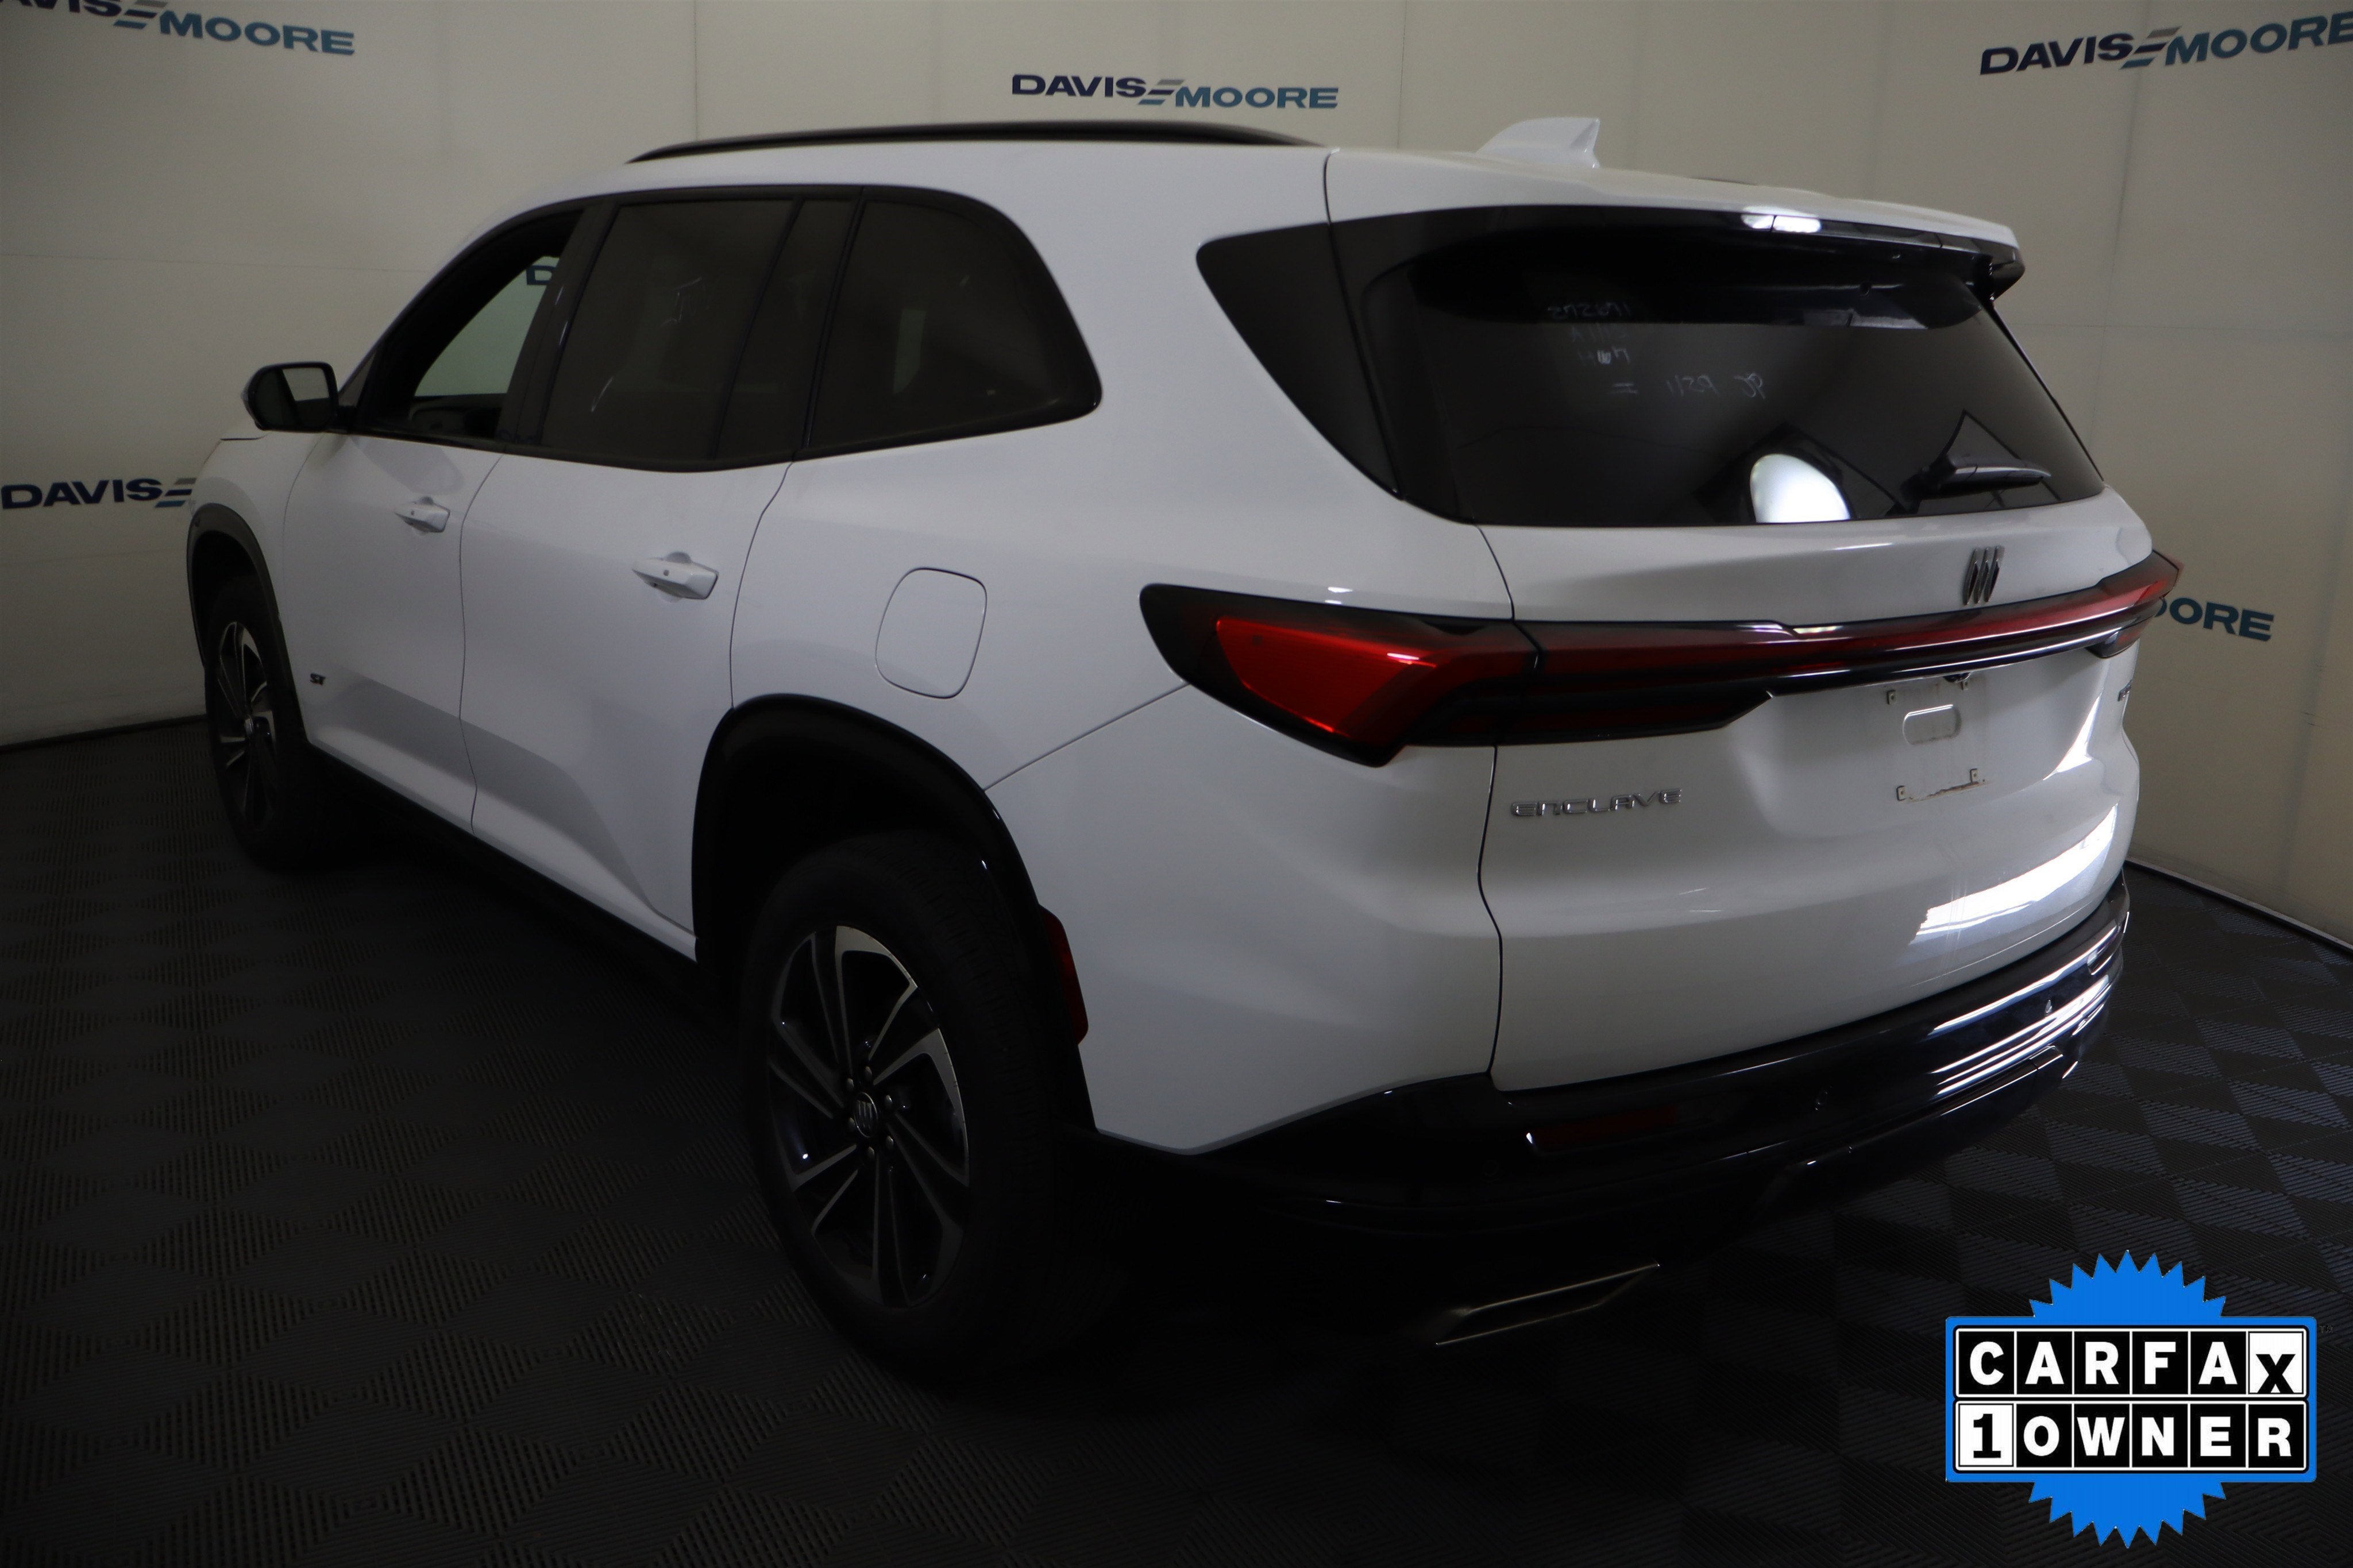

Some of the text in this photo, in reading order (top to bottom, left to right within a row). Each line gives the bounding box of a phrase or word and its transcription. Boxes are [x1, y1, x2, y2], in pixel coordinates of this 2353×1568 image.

[160, 9, 354, 56] MOORE
[1980, 11, 2353, 75] DAVIS MOORE
[1012, 74, 1338, 109] DAVIS MOORE
[1, 478, 163, 509] DAVIS
[1511, 787, 1682, 816] ENCLAVE
